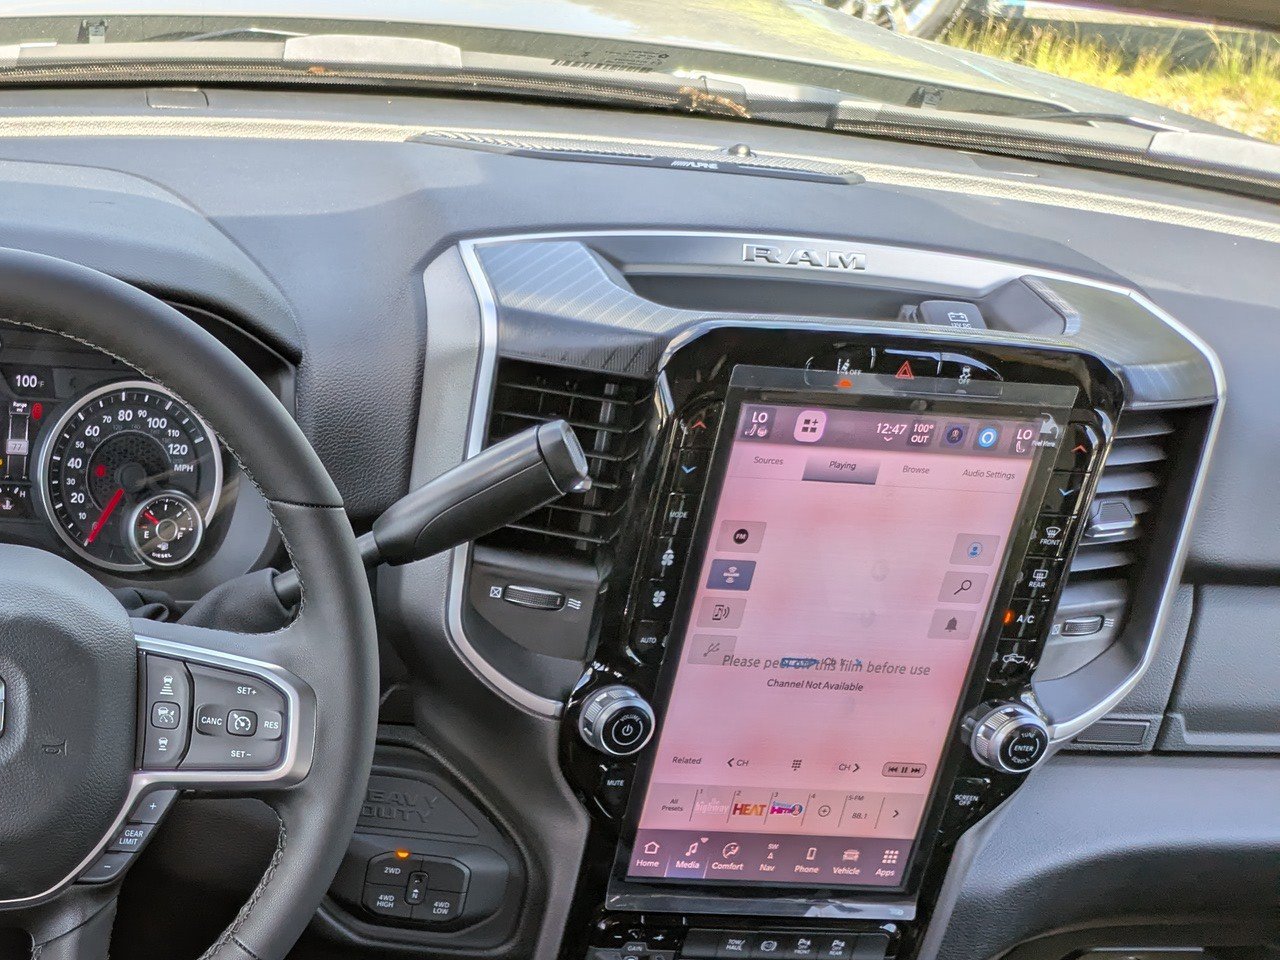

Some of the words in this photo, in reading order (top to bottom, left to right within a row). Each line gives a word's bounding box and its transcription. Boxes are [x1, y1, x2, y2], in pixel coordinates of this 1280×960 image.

[742, 243, 866, 270] RAM
[118, 410, 133, 422] 80
[138, 410, 148, 418] 90
[752, 412, 768, 423] LO
[102, 415, 112, 424] 70
[147, 417, 167, 429] 100
[84, 426, 100, 438] 60
[876, 423, 908, 434] 12:47
[168, 429, 180, 438] 110
[1016, 429, 1032, 440] LO
[910, 435, 929, 444] OUT
[168, 444, 188, 456] 120
[68, 458, 82, 469] 40
[754, 456, 784, 466] Sources
[174, 464, 194, 472] MPH
[829, 461, 857, 471] Playing
[902, 466, 930, 474] Browse
[962, 470, 985, 478] Audio
[986, 471, 1016, 480] Settings
[70, 492, 84, 504] 20
[144, 530, 150, 538] E
[177, 532, 184, 540] F
[1016, 615, 1036, 624] A/C
[722, 654, 761, 668] Please
[866, 660, 907, 674] before
[910, 667, 931, 676] use
[766, 678, 804, 689] Channel
[805, 680, 822, 690] Not
[823, 681, 864, 692] Available
[201, 716, 222, 725] CANC
[264, 721, 279, 729] RES
[672, 756, 702, 765] Related
[732, 803, 767, 816] HEAT
[635, 858, 660, 868] Home
[676, 860, 700, 869] Media
[712, 862, 744, 871] Comfort
[384, 866, 401, 875] 2WD
[794, 865, 819, 874] Phone
[832, 866, 861, 875] Vehicle
[875, 869, 896, 877] Apps
